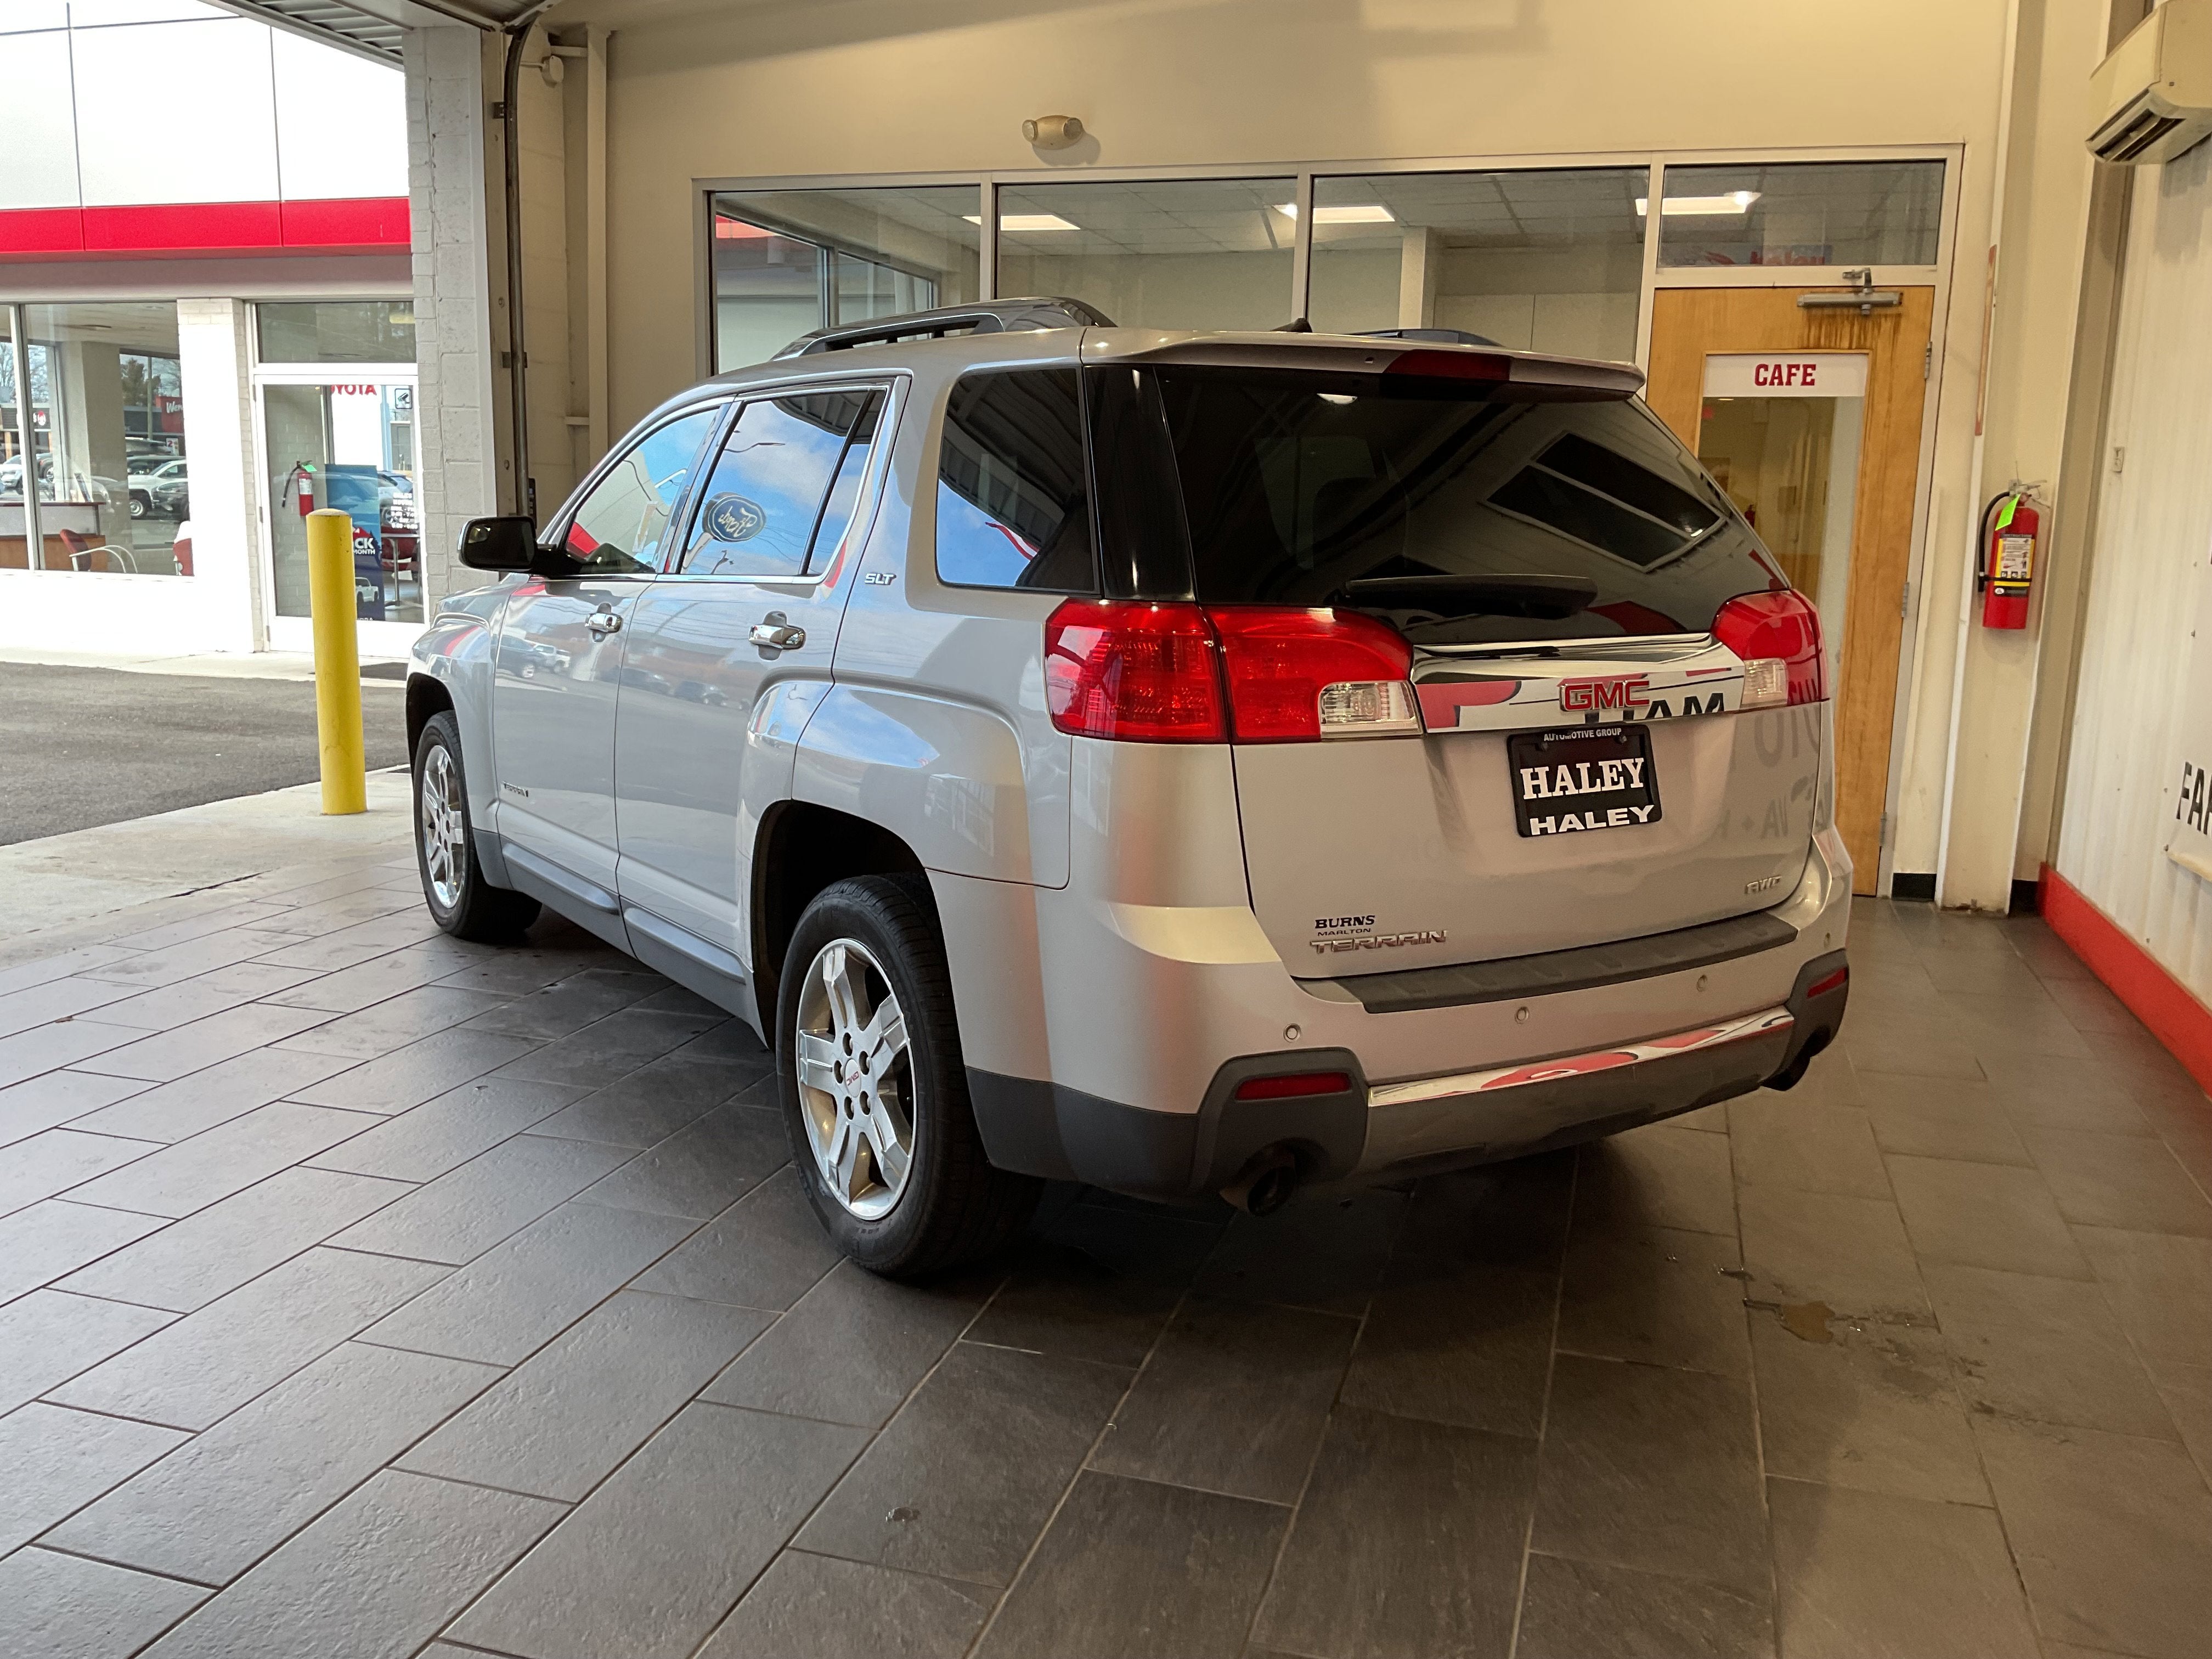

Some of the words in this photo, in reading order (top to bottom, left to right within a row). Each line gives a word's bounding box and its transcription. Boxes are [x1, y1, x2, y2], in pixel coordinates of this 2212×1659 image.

[1754, 363, 1816, 386] CAFE
[864, 573, 896, 585] SLT
[1559, 679, 1650, 712] GMC
[1596, 727, 1622, 737] GROUP
[1520, 757, 1644, 800] HALEY
[1530, 804, 1655, 836] HALEY
[1315, 915, 1375, 929] BURNS
[1317, 928, 1371, 936] MARLTON
[1310, 930, 1448, 954] TERRAIN
